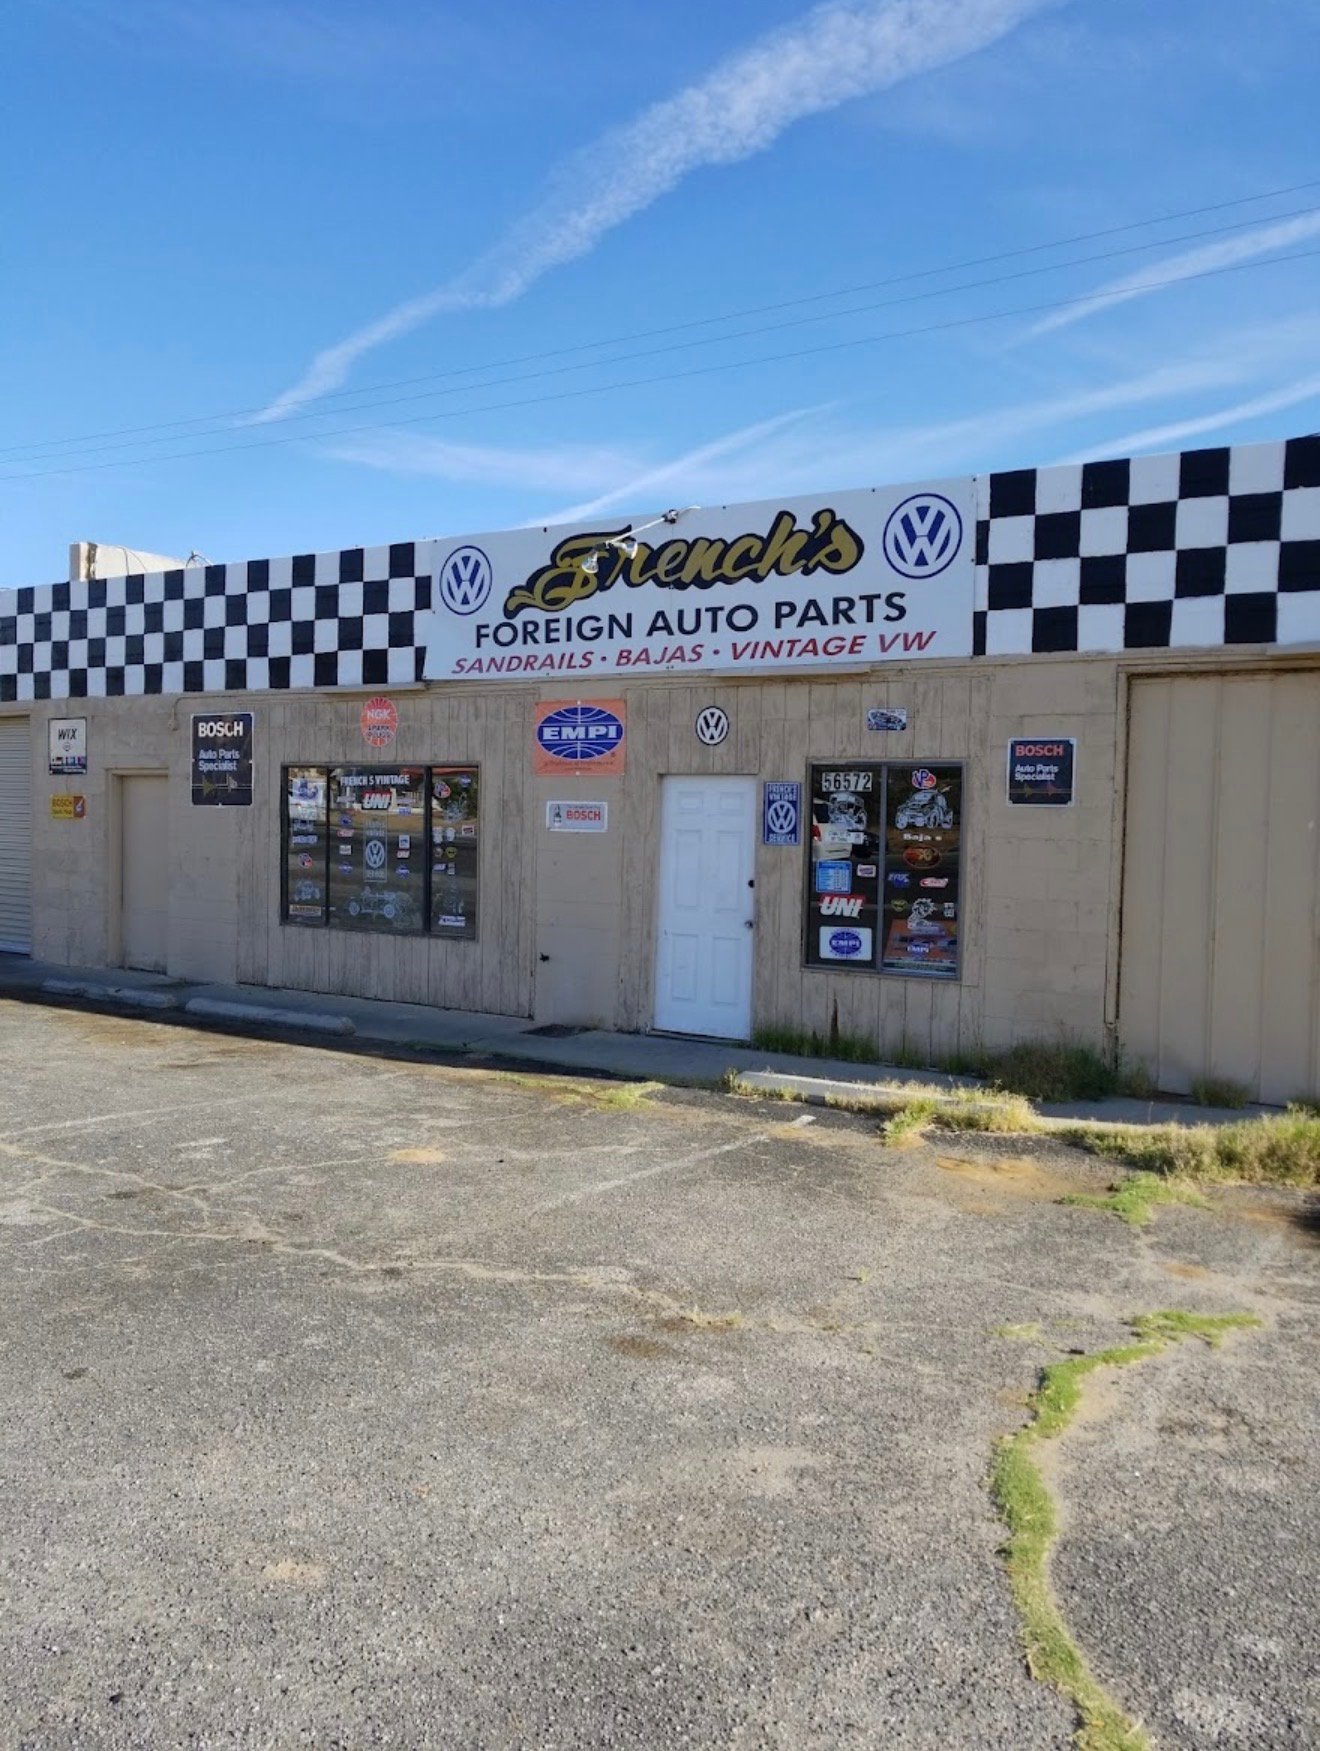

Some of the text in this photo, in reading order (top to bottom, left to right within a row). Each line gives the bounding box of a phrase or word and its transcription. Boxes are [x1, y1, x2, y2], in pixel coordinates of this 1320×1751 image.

[503, 508, 864, 619] French's
[475, 592, 907, 648] FOREIGN AUTO PARTS
[451, 630, 937, 674] SANDRAILS BAJAS VINTAGE VW
[367, 708, 391, 719] NGK
[58, 728, 78, 740] WIX
[198, 721, 244, 737] BOSCH
[542, 725, 618, 740] EMPI
[199, 749, 240, 759] Auto Parts
[1015, 745, 1064, 756] BOSCH
[198, 760, 238, 772] Specialist
[1015, 764, 1059, 773] Auto Parts
[375, 774, 410, 785] VINTAGE
[822, 773, 873, 790] 56572
[1015, 773, 1056, 781] Specialist
[566, 810, 601, 820] BOSCH
[820, 896, 863, 918] UNI
